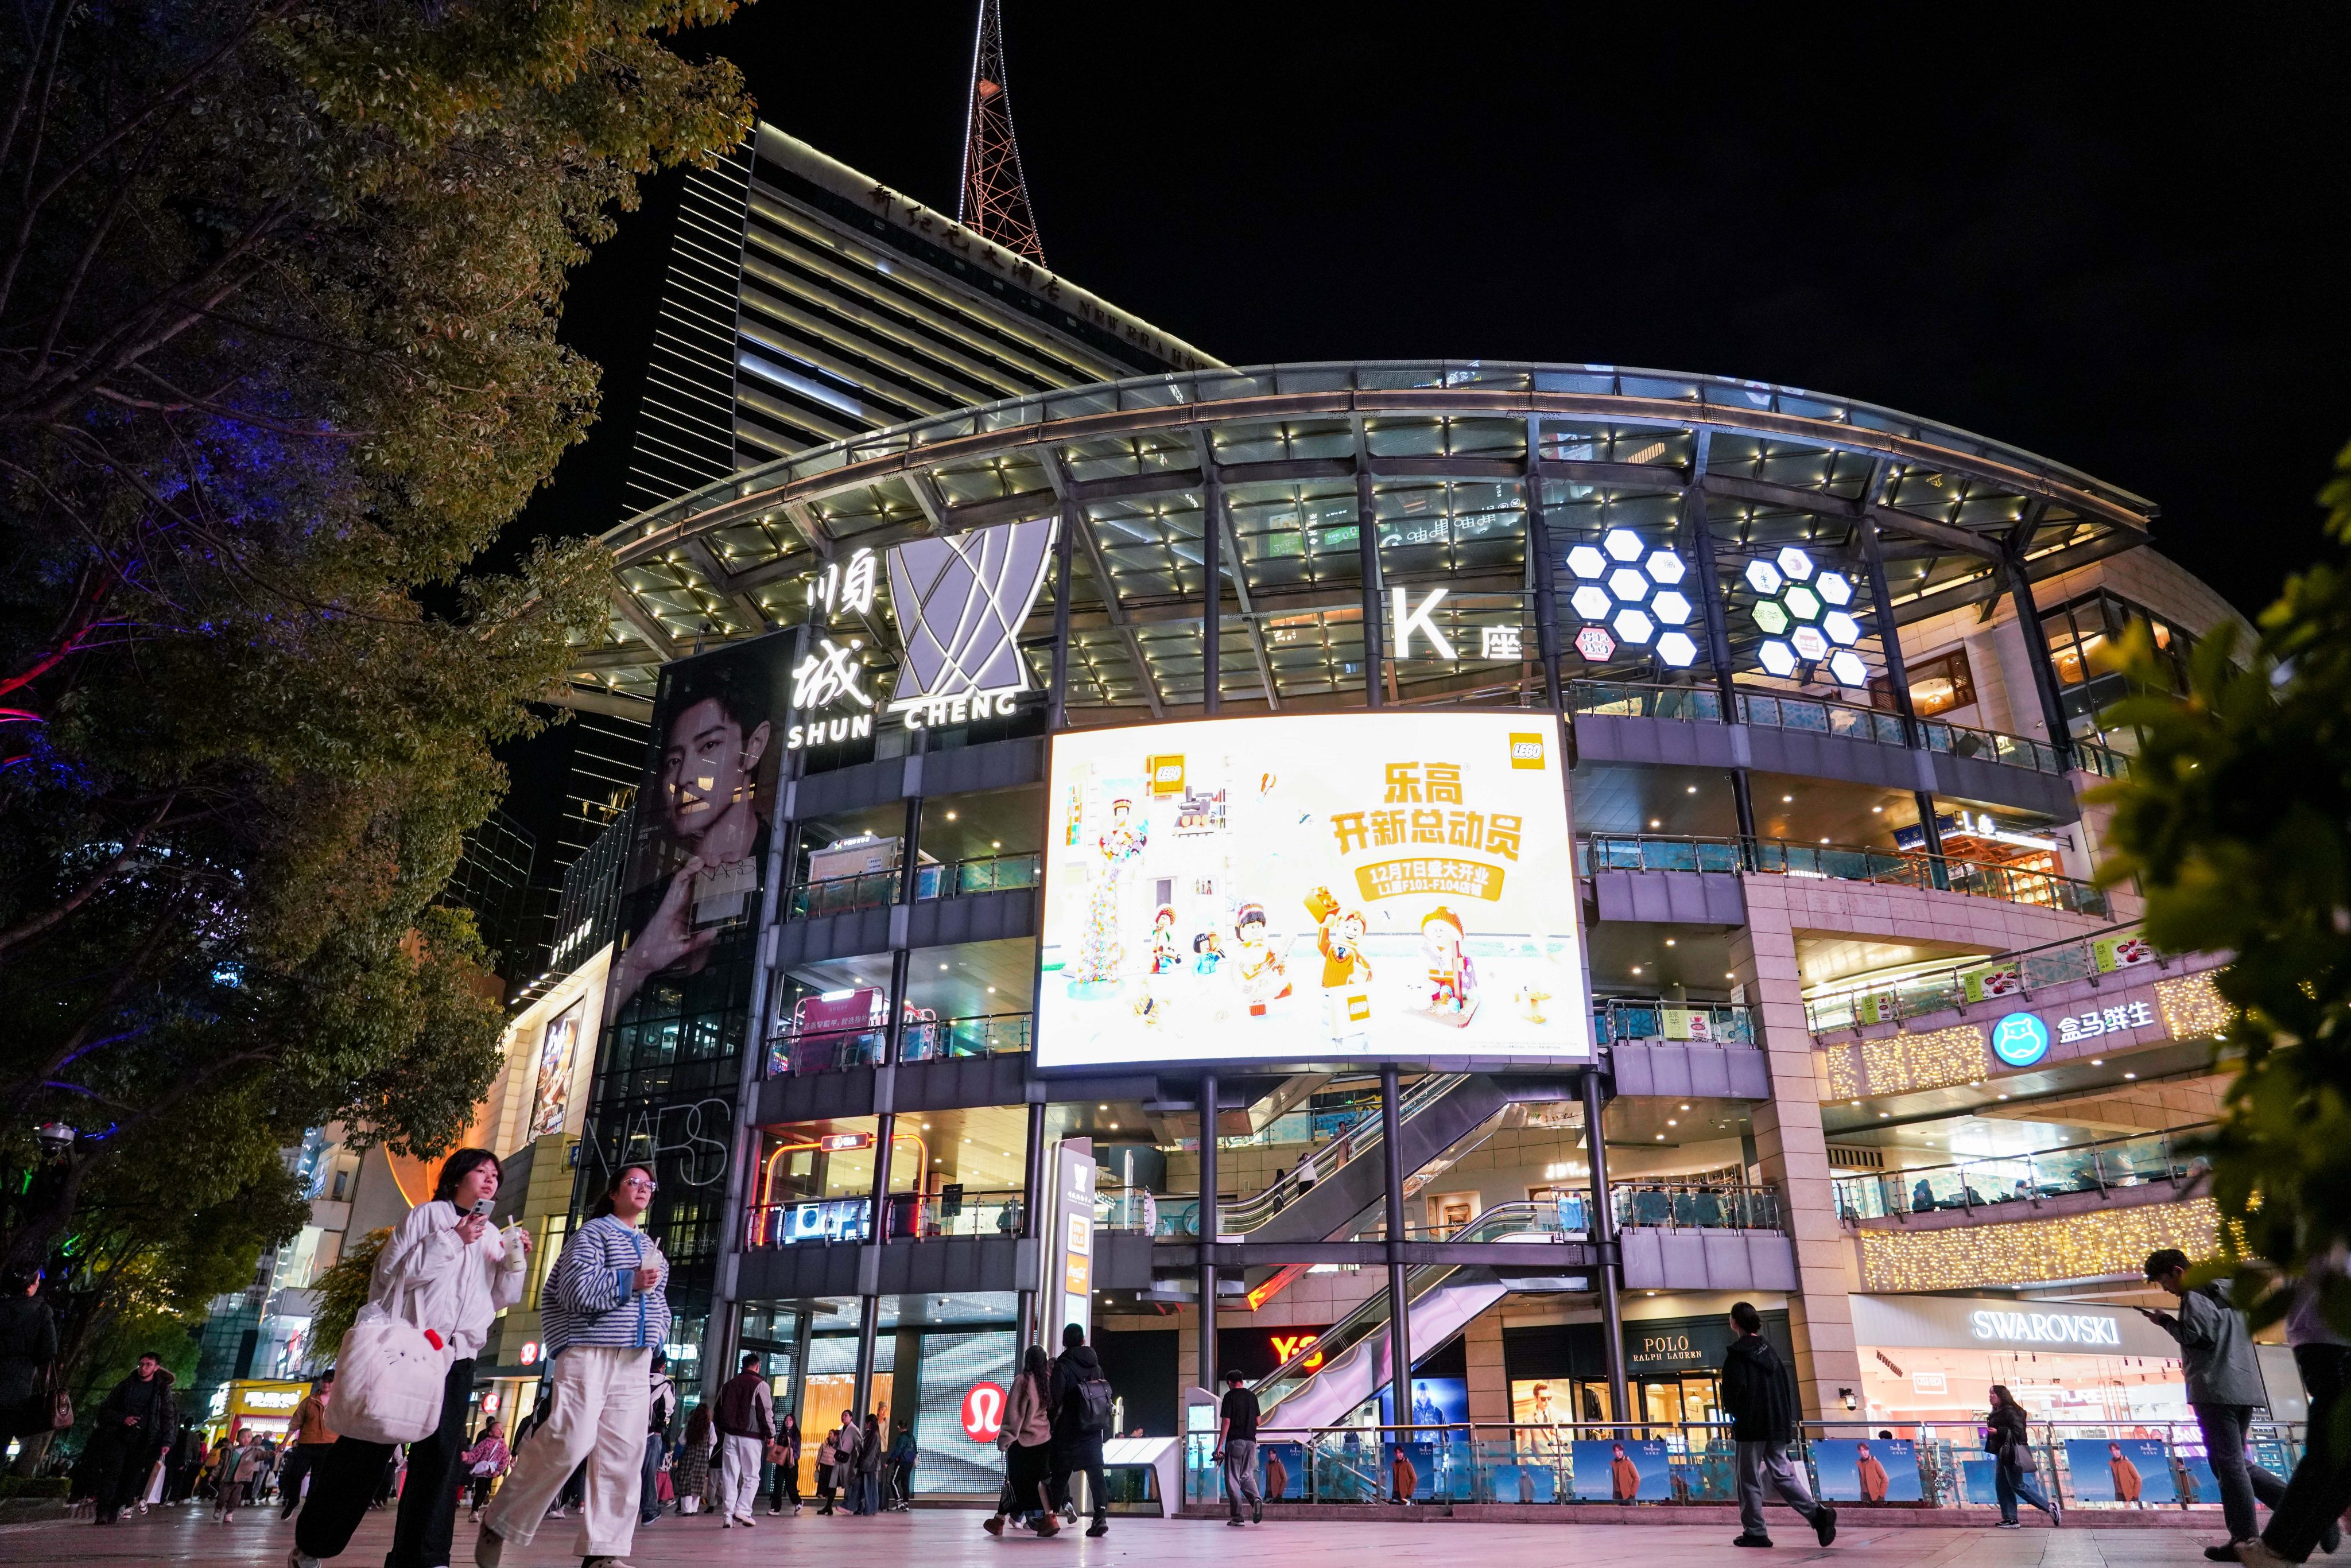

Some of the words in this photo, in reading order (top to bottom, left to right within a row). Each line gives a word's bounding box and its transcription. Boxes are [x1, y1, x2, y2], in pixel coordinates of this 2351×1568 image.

[1078, 300, 1119, 331] NEW
[1126, 324, 1163, 355] ERA
[1392, 587, 1458, 659] K
[1481, 625, 1523, 659] 座
[787, 713, 872, 750] SHUN
[904, 692, 1017, 731] CHENG
[1512, 742, 1543, 759] LEGO
[1156, 765, 1182, 782] LEGO
[1384, 760, 1464, 805] 乐高
[1329, 808, 1523, 863] 开新总动员
[696, 857, 755, 884] NARS
[1369, 860, 1489, 886] 12月7日盛大开业
[2057, 1001, 2155, 1044] 盒马鲜生
[586, 1098, 731, 1191] NARS
[1073, 1223, 1084, 1234] UNI
[1073, 1234, 1084, 1245] QLO
[1973, 1310, 2120, 1344] SWAROVSKI
[1634, 1353, 1662, 1362] RALPH
[1667, 1351, 1702, 1360] LAUREN
[1643, 1336, 1689, 1352] POLO
